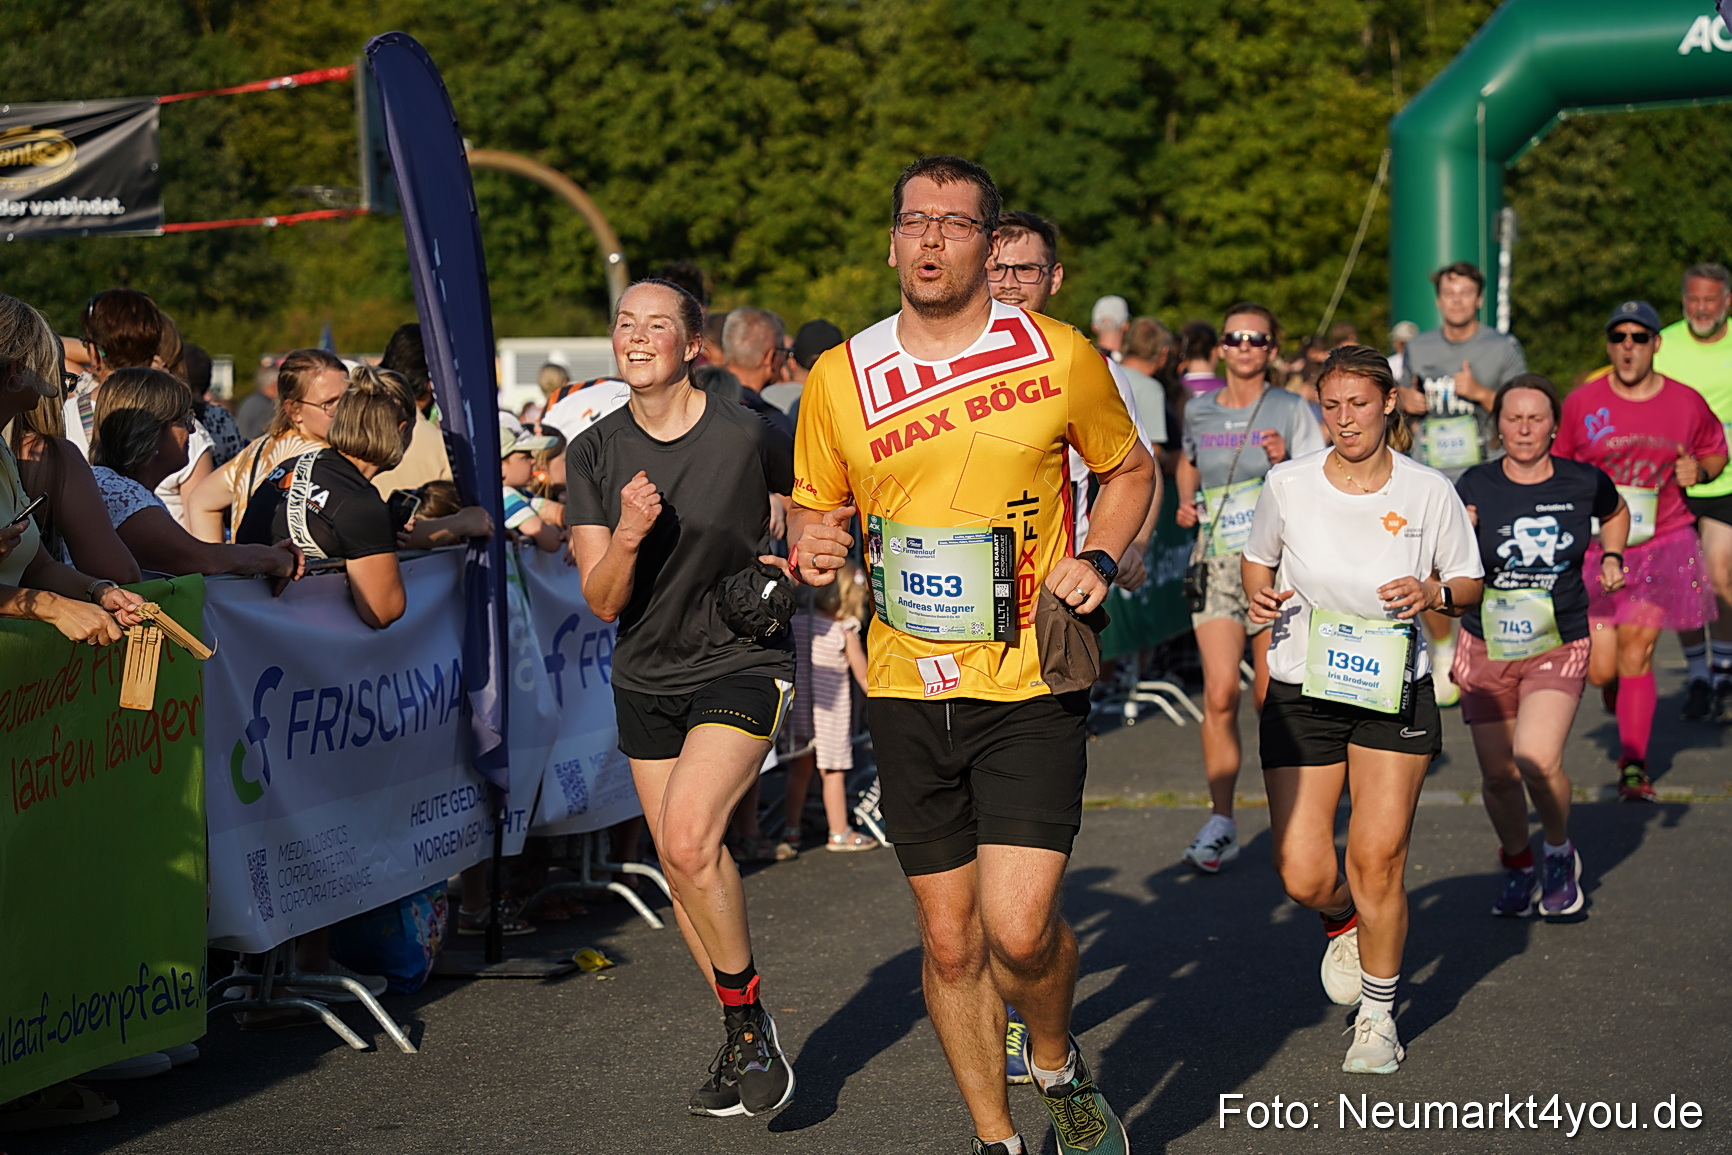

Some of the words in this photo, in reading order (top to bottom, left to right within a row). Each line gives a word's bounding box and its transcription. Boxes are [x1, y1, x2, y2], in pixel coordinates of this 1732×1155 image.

[29, 195, 126, 216] verbindet.
[869, 407, 957, 464] MAX
[964, 375, 1062, 425] BÖGL
[868, 523, 881, 531] AOK
[903, 547, 936, 556] Firmenlauf
[900, 569, 963, 598] 1853
[898, 596, 932, 612] Andreas
[934, 603, 975, 615] Wagner
[997, 600, 1005, 633] HILTL
[1498, 620, 1533, 634] 743
[1327, 649, 1380, 677] 1394
[1328, 671, 1341, 681] Iris
[12, 724, 95, 814] laufen
[410, 792, 448, 828] HEUTE
[413, 828, 464, 867] MORGEN
[278, 854, 336, 888] CORPORATE
[280, 879, 337, 914] CORPORATE
